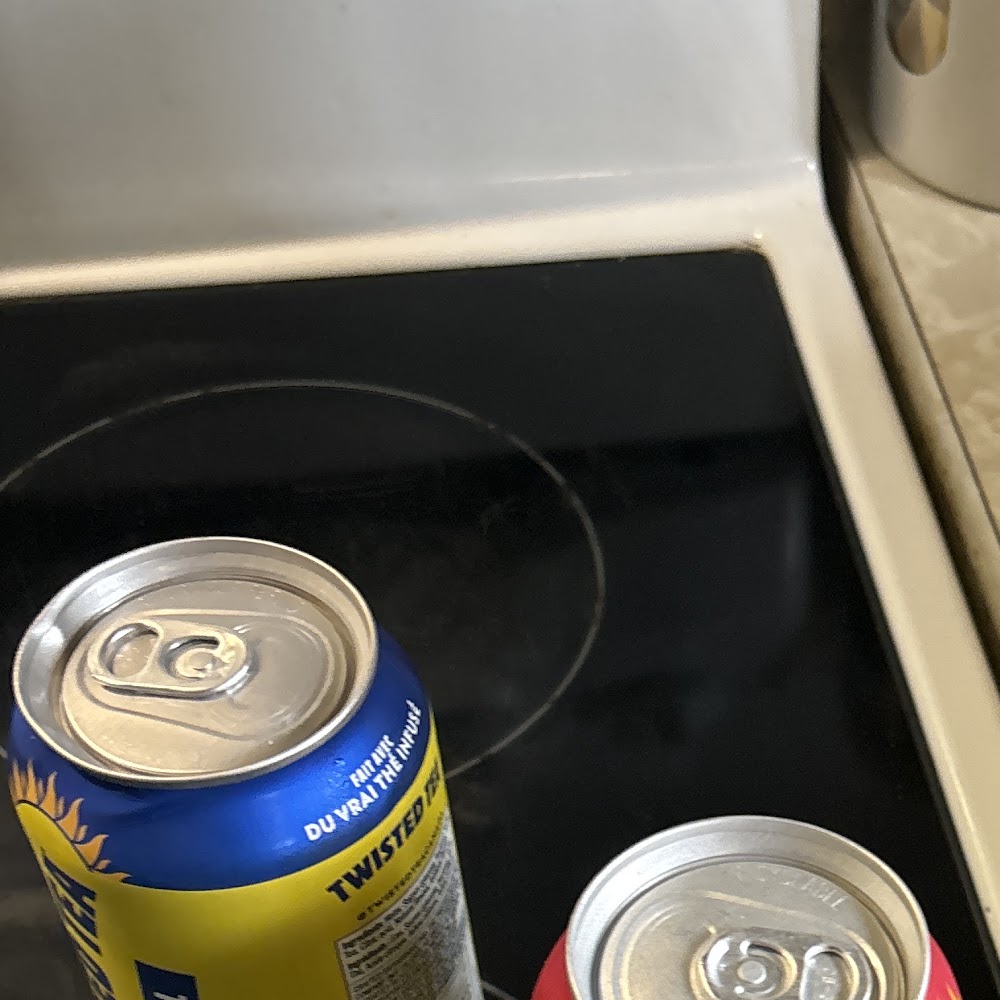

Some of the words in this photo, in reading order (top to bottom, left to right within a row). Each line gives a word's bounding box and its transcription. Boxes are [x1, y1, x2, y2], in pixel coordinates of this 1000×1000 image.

[303, 814, 337, 841] DU
[334, 784, 379, 821] VRAI
[373, 752, 403, 790] THÉ
[349, 760, 376, 788] FAIT
[326, 796, 424, 903] TWISTED
